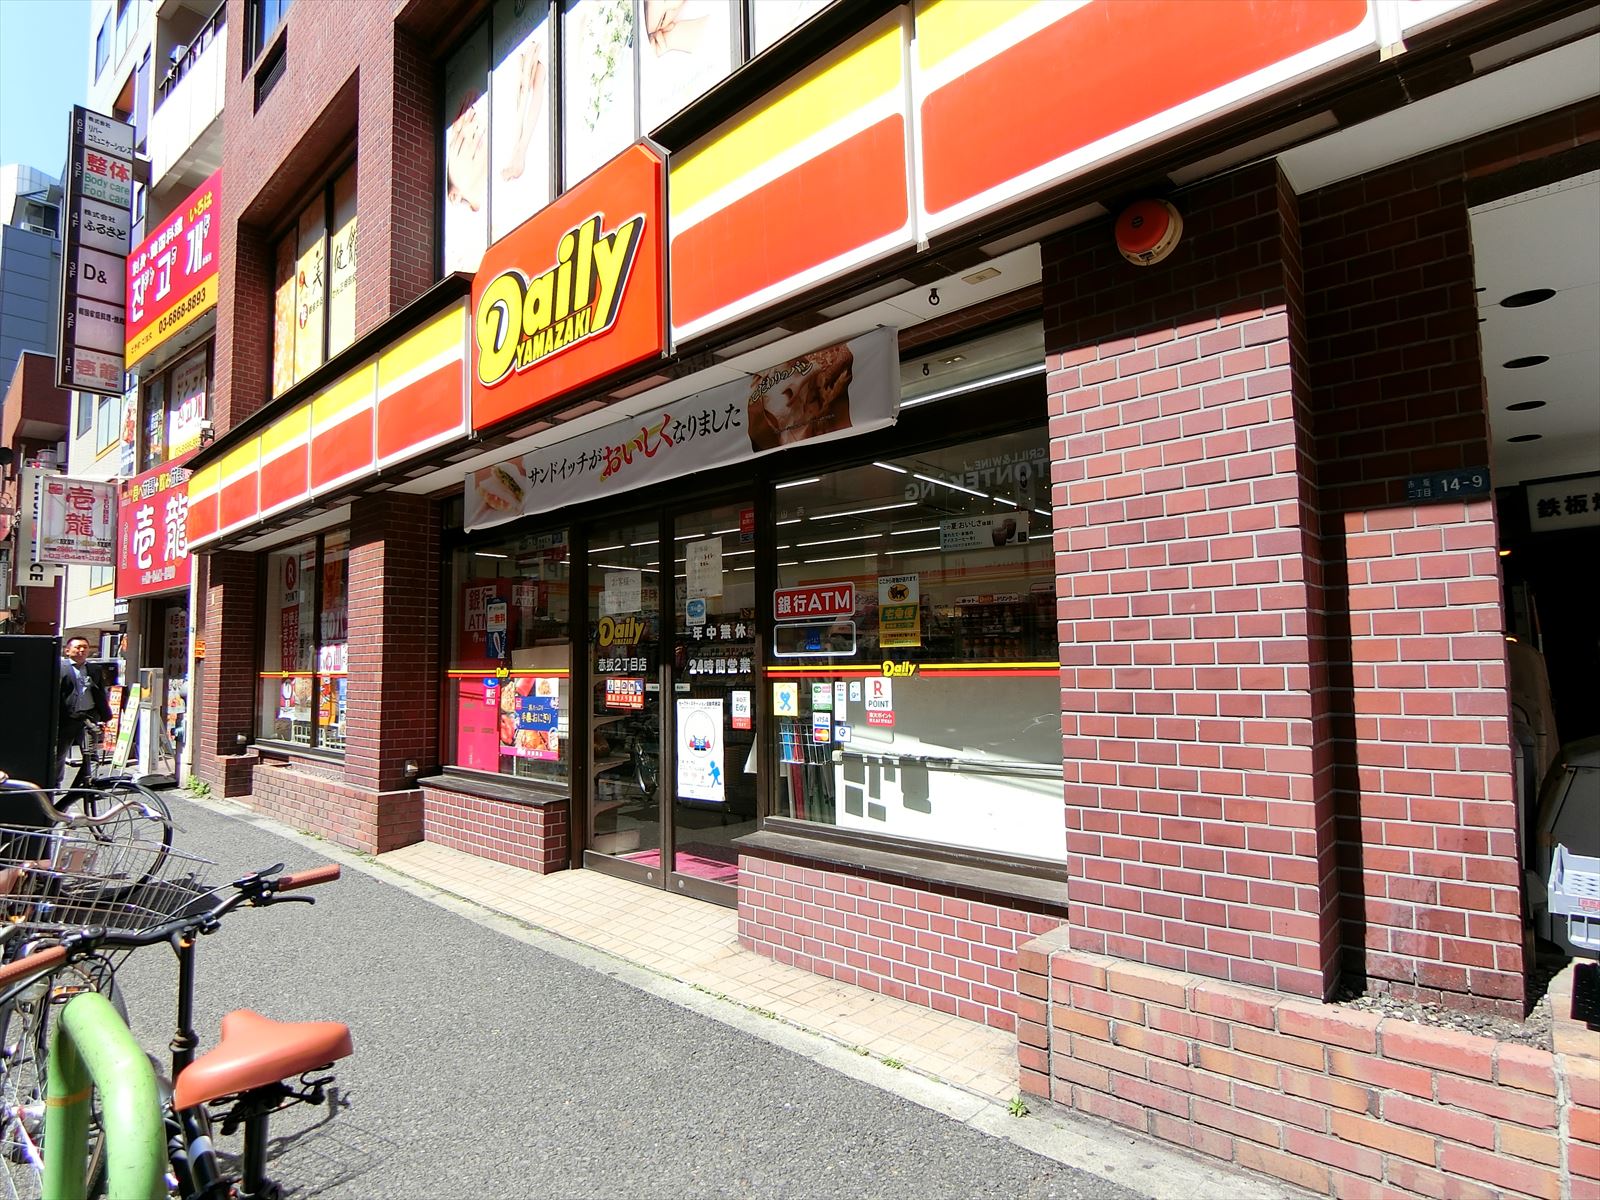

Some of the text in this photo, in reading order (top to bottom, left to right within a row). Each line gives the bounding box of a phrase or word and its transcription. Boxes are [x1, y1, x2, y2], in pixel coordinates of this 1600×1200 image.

[86, 152, 130, 183] 整体
[85, 172, 130, 195] Body care
[109, 192, 129, 207] care
[188, 191, 213, 223] いろは
[84, 209, 116, 224] 株式会社
[84, 218, 128, 241] ふるさと
[83, 263, 108, 285] D&
[477, 215, 645, 385] Daily
[158, 287, 207, 335] 03-6868-8893
[516, 306, 593, 370] YAMAZAKI
[528, 403, 741, 488] サンドイッチがおいしくなりました
[1441, 474, 1483, 492] 14-9
[1408, 488, 1432, 499] 二丁目
[777, 590, 850, 615] 銀行ATM
[598, 616, 645, 647] Daily
[693, 623, 747, 641] 年中無休
[598, 657, 647, 672] 赤坂2丁目店
[689, 657, 751, 675] 24時間営業
[882, 660, 917, 677] Daily
[873, 680, 885, 696] R
[736, 704, 747, 712] Edy
[868, 700, 889, 708] POINT
